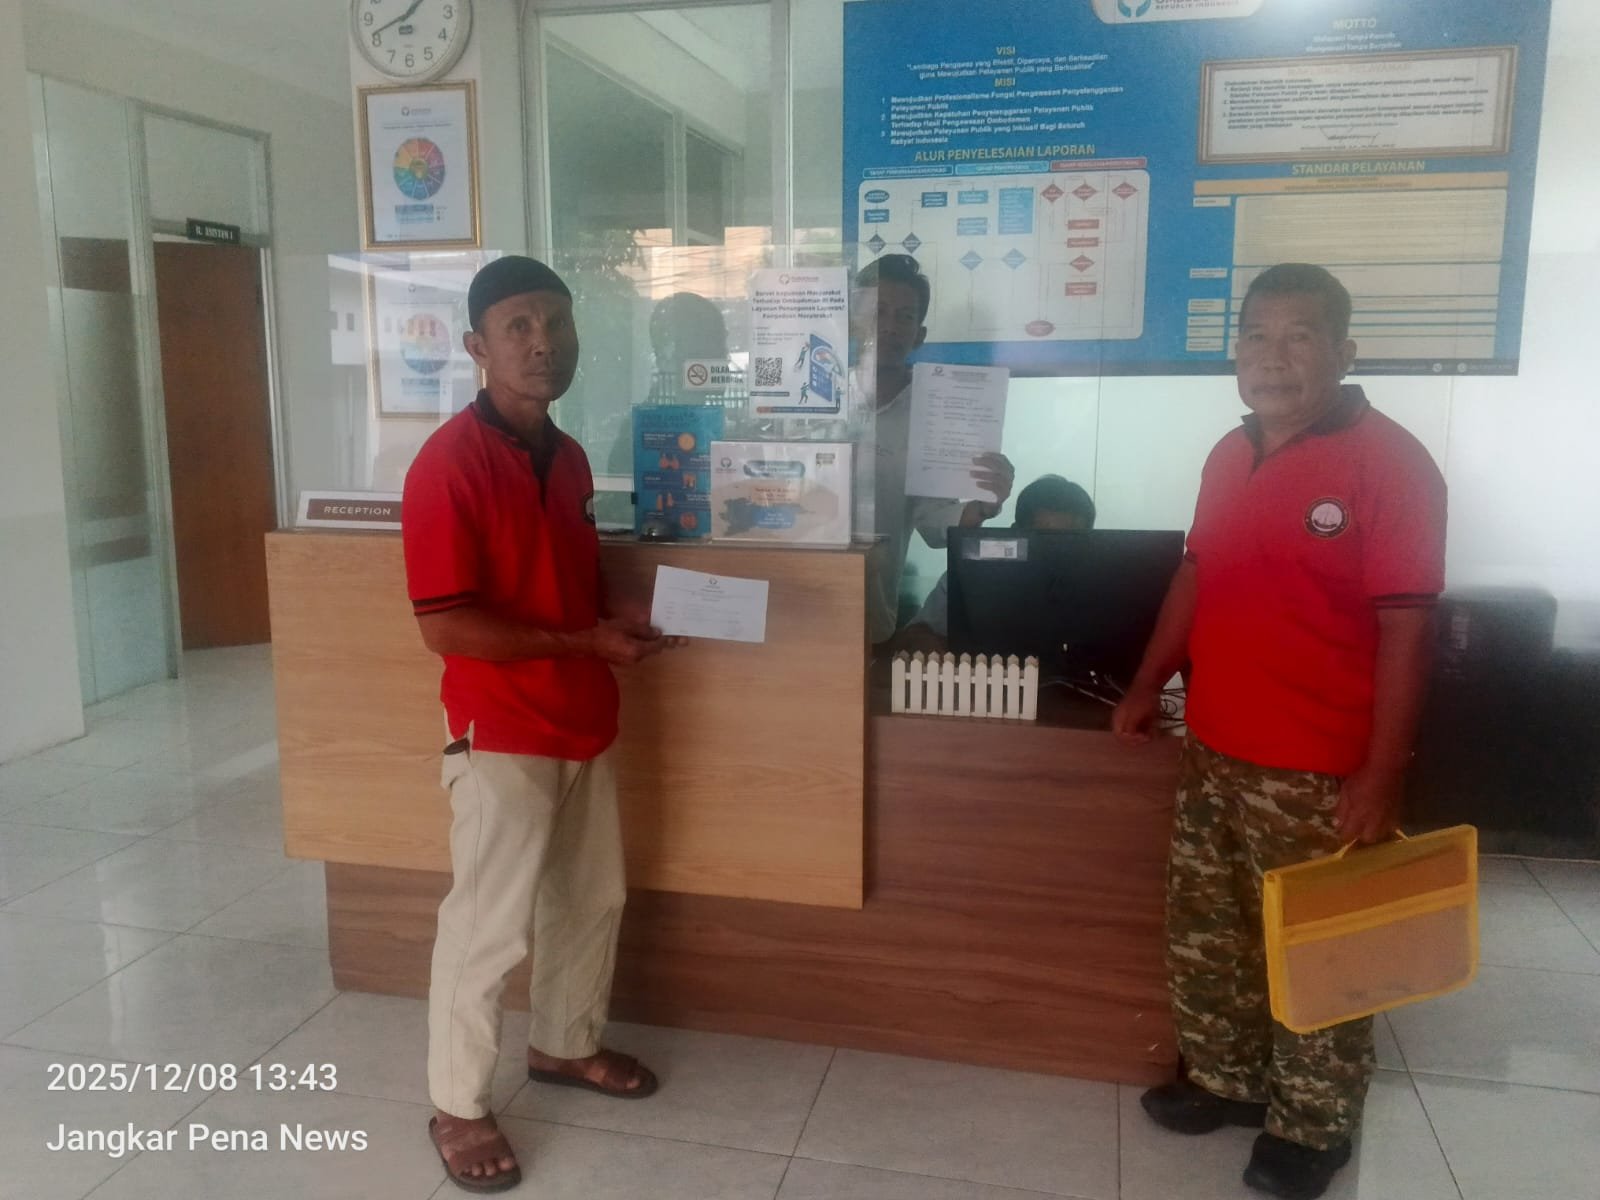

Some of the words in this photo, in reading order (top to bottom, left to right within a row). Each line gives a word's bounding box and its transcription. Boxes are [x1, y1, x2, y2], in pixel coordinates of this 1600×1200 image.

[364, 11, 373, 26] 9
[442, 4, 453, 20] 3
[1332, 17, 1376, 29] MOTTO
[372, 32, 382, 47] 8
[438, 27, 448, 41] 4
[386, 49, 396, 63] 7
[424, 46, 433, 61] 5
[996, 47, 1015, 56] VISI
[405, 54, 415, 67] 6
[994, 78, 1015, 88] MISI
[914, 150, 946, 162] ALUR
[947, 146, 1037, 160] PENYELESAIAN
[1037, 144, 1095, 157] LAPORAN
[1292, 163, 1349, 175] STANDAR
[1352, 161, 1425, 174] PELAYANAN
[323, 506, 391, 516] RECEPTION
